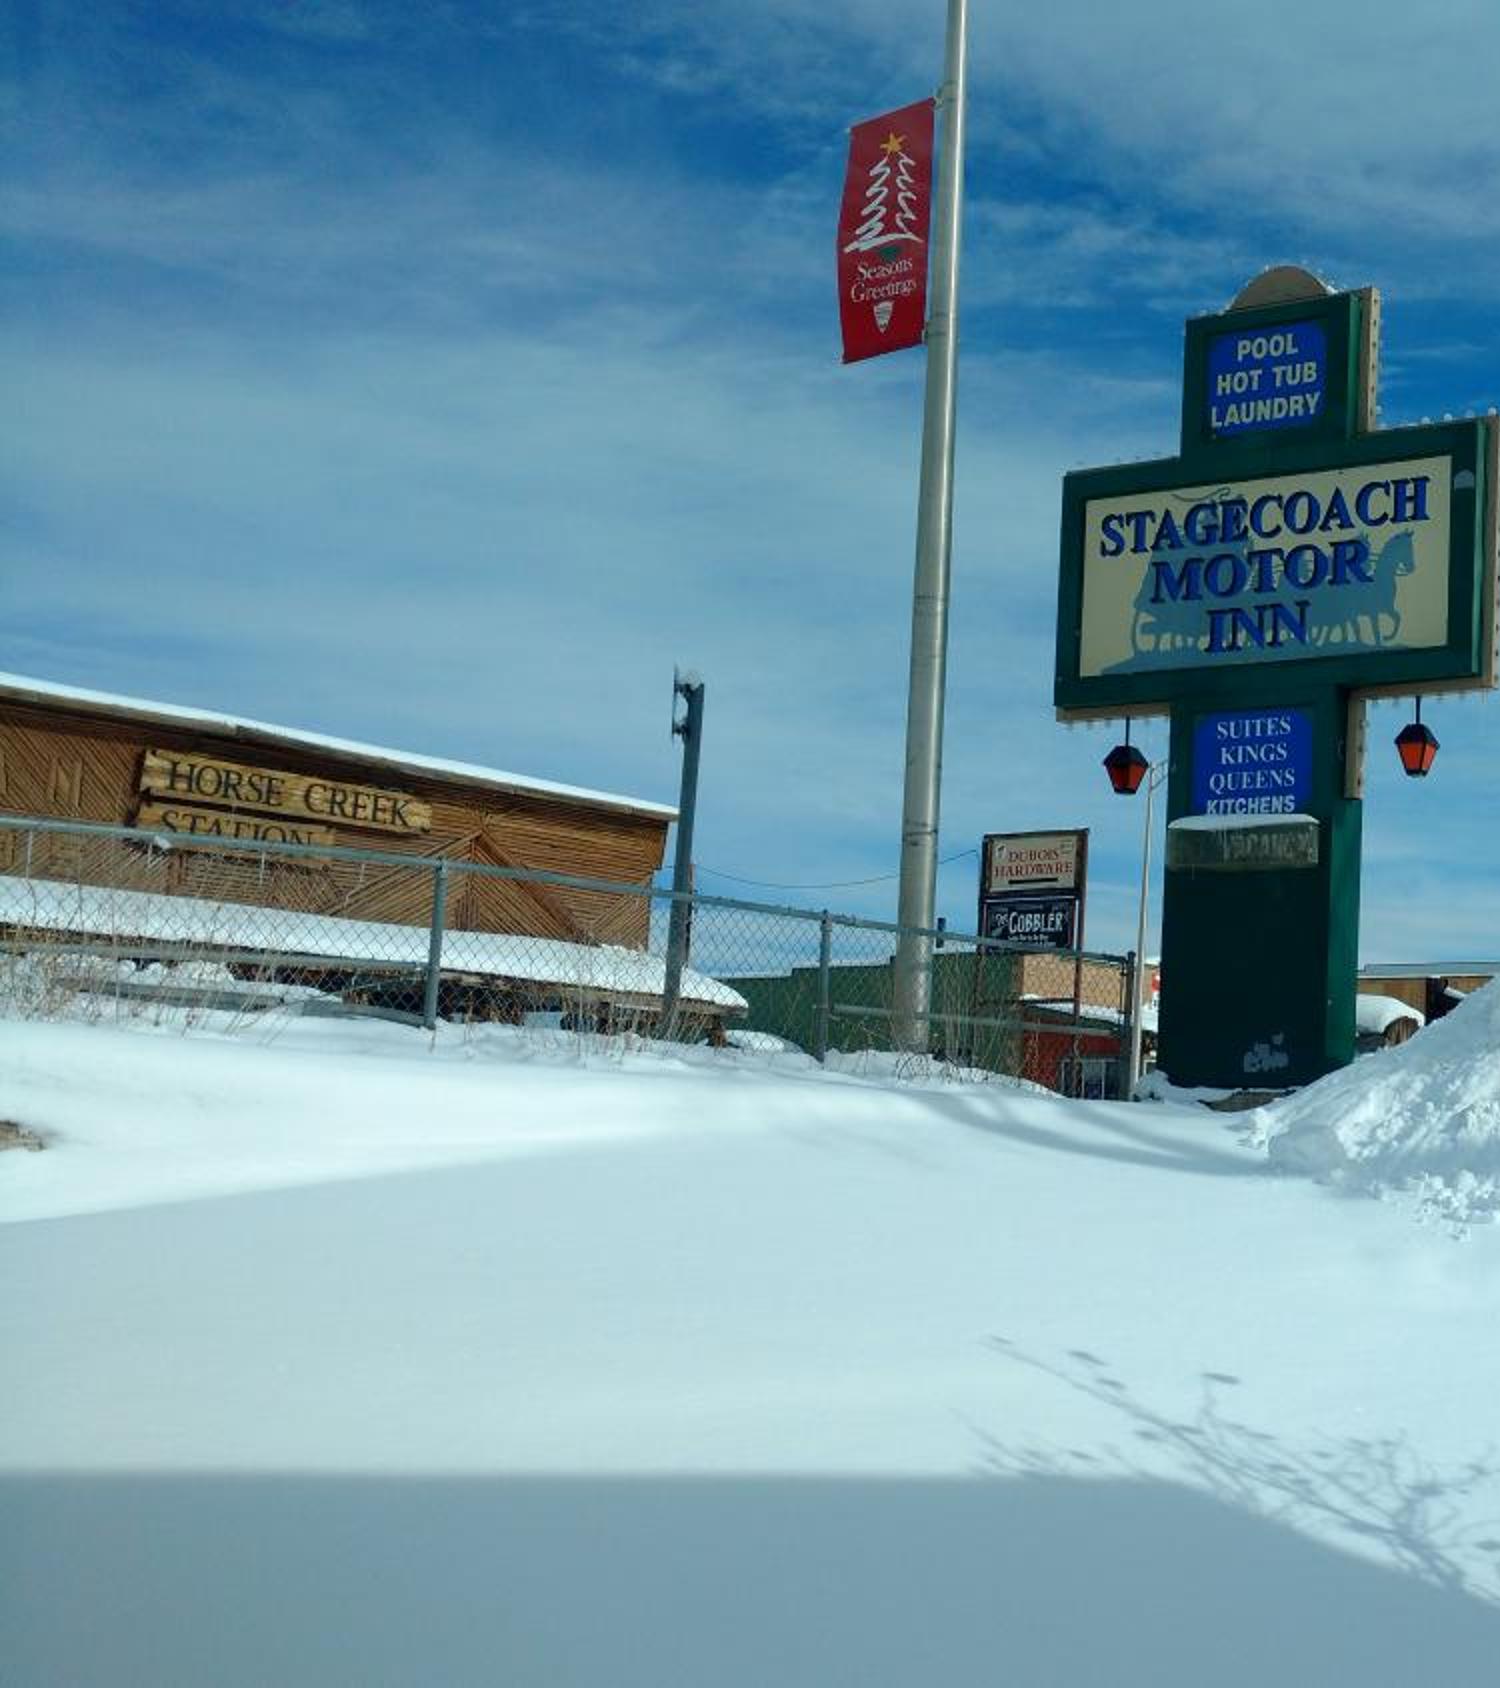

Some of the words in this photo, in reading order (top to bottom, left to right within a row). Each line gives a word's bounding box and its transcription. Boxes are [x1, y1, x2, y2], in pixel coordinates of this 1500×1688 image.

[851, 279, 917, 302] Greetings
[1237, 332, 1298, 361] POOL
[1216, 369, 1262, 397] HOT
[1273, 361, 1318, 388] TUB
[1211, 392, 1321, 428] LAUNDRY
[1100, 476, 1431, 557] STAGECOACH
[1150, 538, 1373, 604] MOTOR
[1204, 600, 1311, 653] INN
[1217, 716, 1291, 740] SUITES
[1220, 743, 1288, 765] KINGS
[166, 759, 285, 807] HORSE
[303, 782, 409, 829] CREEK
[1209, 768, 1295, 795] QUEENS
[1206, 795, 1295, 815] KITCHENS
[994, 861, 1073, 877] HARDWARE
